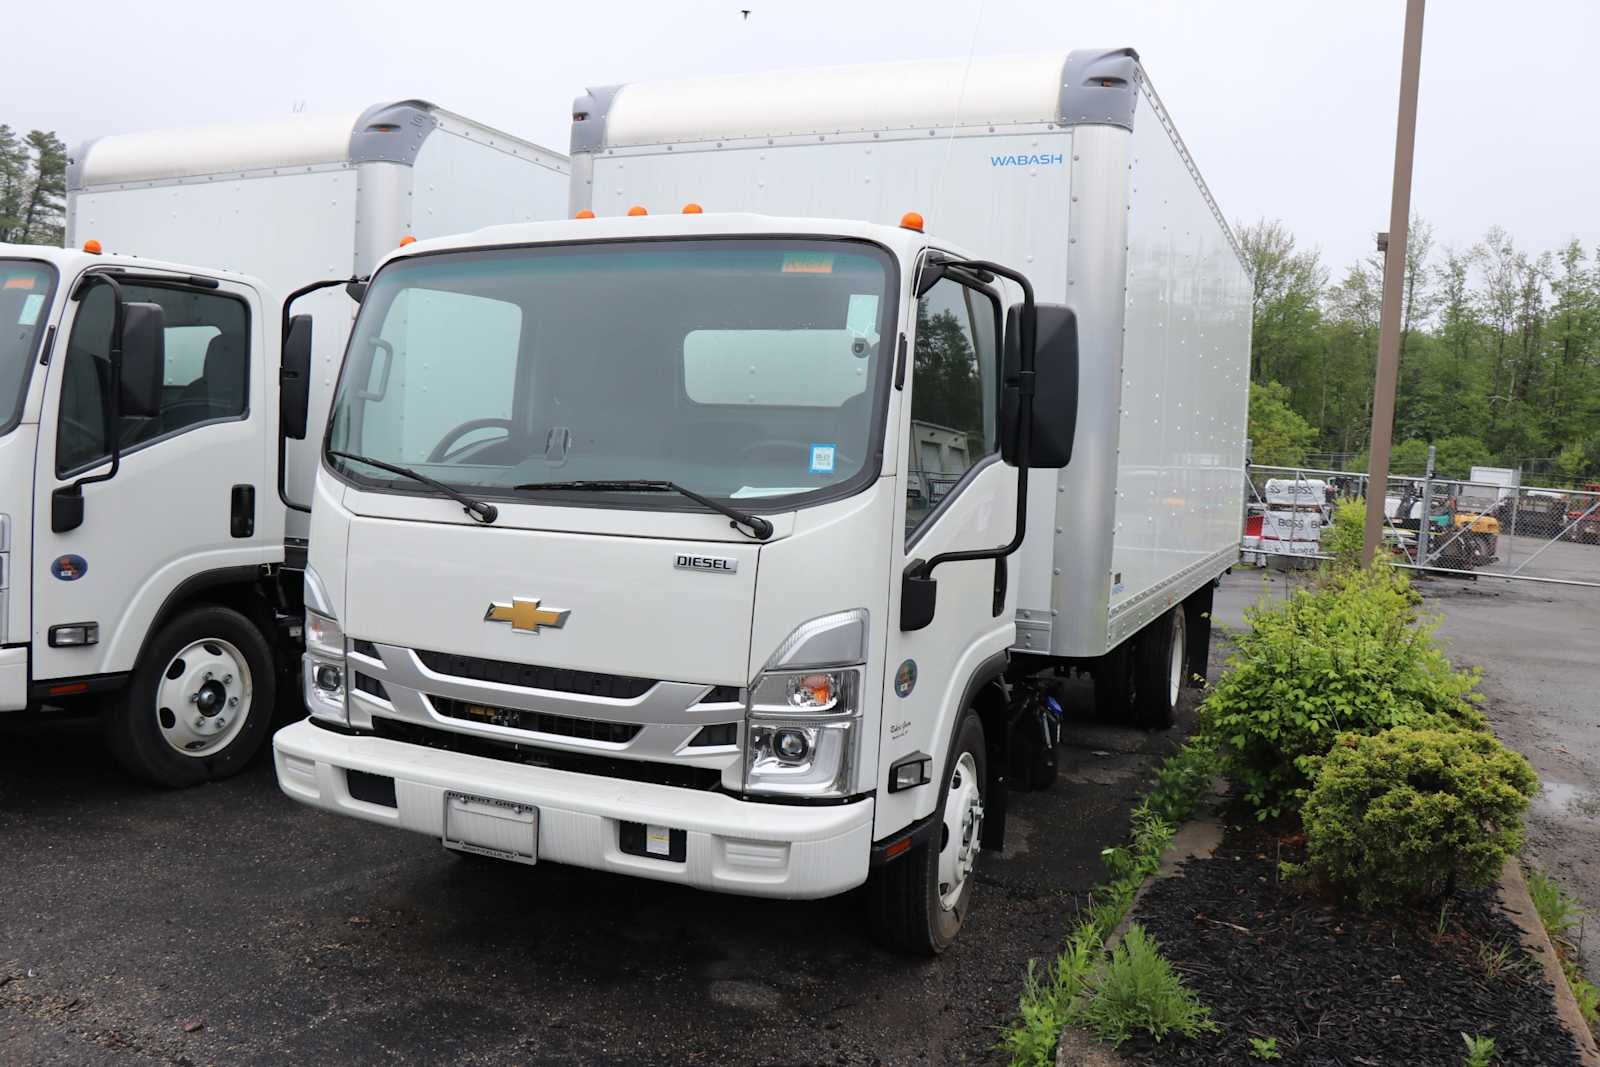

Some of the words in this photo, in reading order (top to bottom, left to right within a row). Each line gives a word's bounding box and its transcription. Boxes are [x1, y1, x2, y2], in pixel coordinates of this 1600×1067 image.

[991, 154, 1063, 166] WABASH
[1288, 486, 1314, 495] BOSS
[1278, 518, 1305, 529] BOSS
[677, 555, 732, 570] DIESEL
